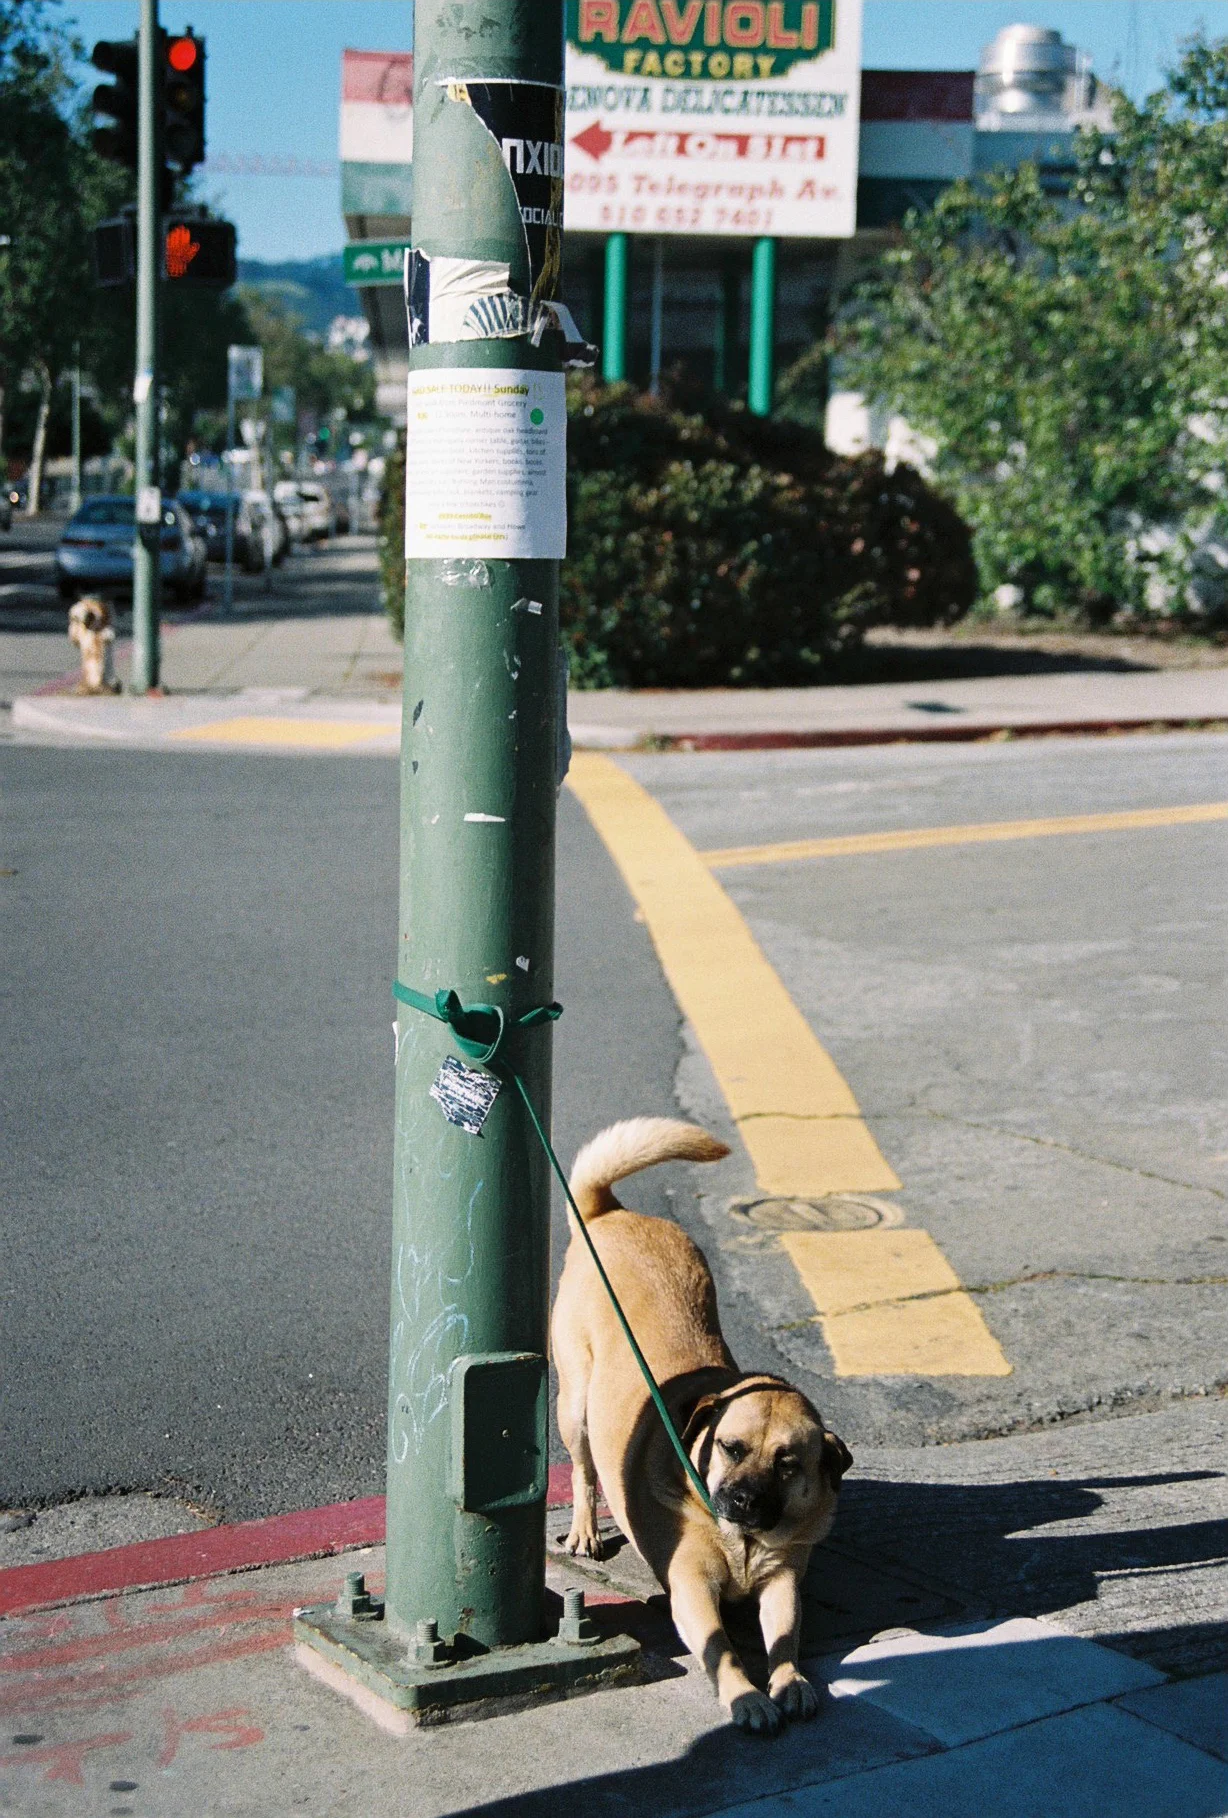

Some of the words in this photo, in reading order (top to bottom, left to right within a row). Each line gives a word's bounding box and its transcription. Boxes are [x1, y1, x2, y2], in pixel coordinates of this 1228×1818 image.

[577, 0, 820, 49] RAVIOLI
[622, 50, 776, 80] FACTORY
[567, 86, 650, 114] ENOVA
[660, 86, 848, 118] DELICATESSEN
[632, 174, 785, 203] Telegraph
[493, 383, 530, 397] Sunday
